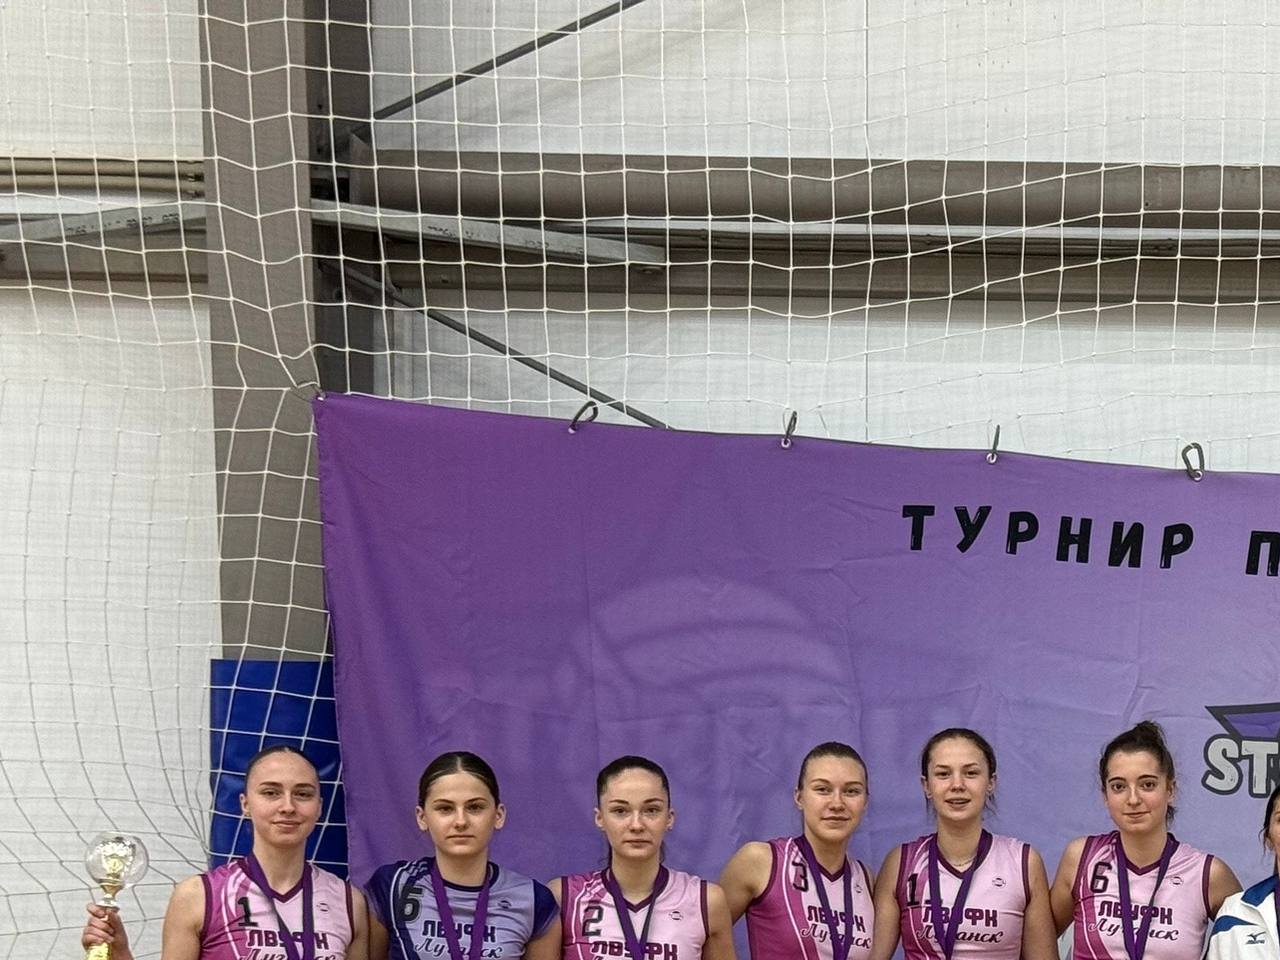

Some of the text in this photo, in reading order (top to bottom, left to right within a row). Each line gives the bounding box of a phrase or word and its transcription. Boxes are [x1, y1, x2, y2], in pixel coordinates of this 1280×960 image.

[902, 504, 1194, 569] ТУРНИР
[792, 860, 810, 893] 3
[1091, 861, 1112, 893] 6
[238, 897, 258, 928] 1
[582, 905, 604, 938] 2
[922, 906, 998, 928] ЛВФК
[801, 923, 872, 949] Луск
[916, 924, 1003, 943] Ланск
[1089, 918, 1180, 942] Луск
[415, 939, 503, 960] Луск
